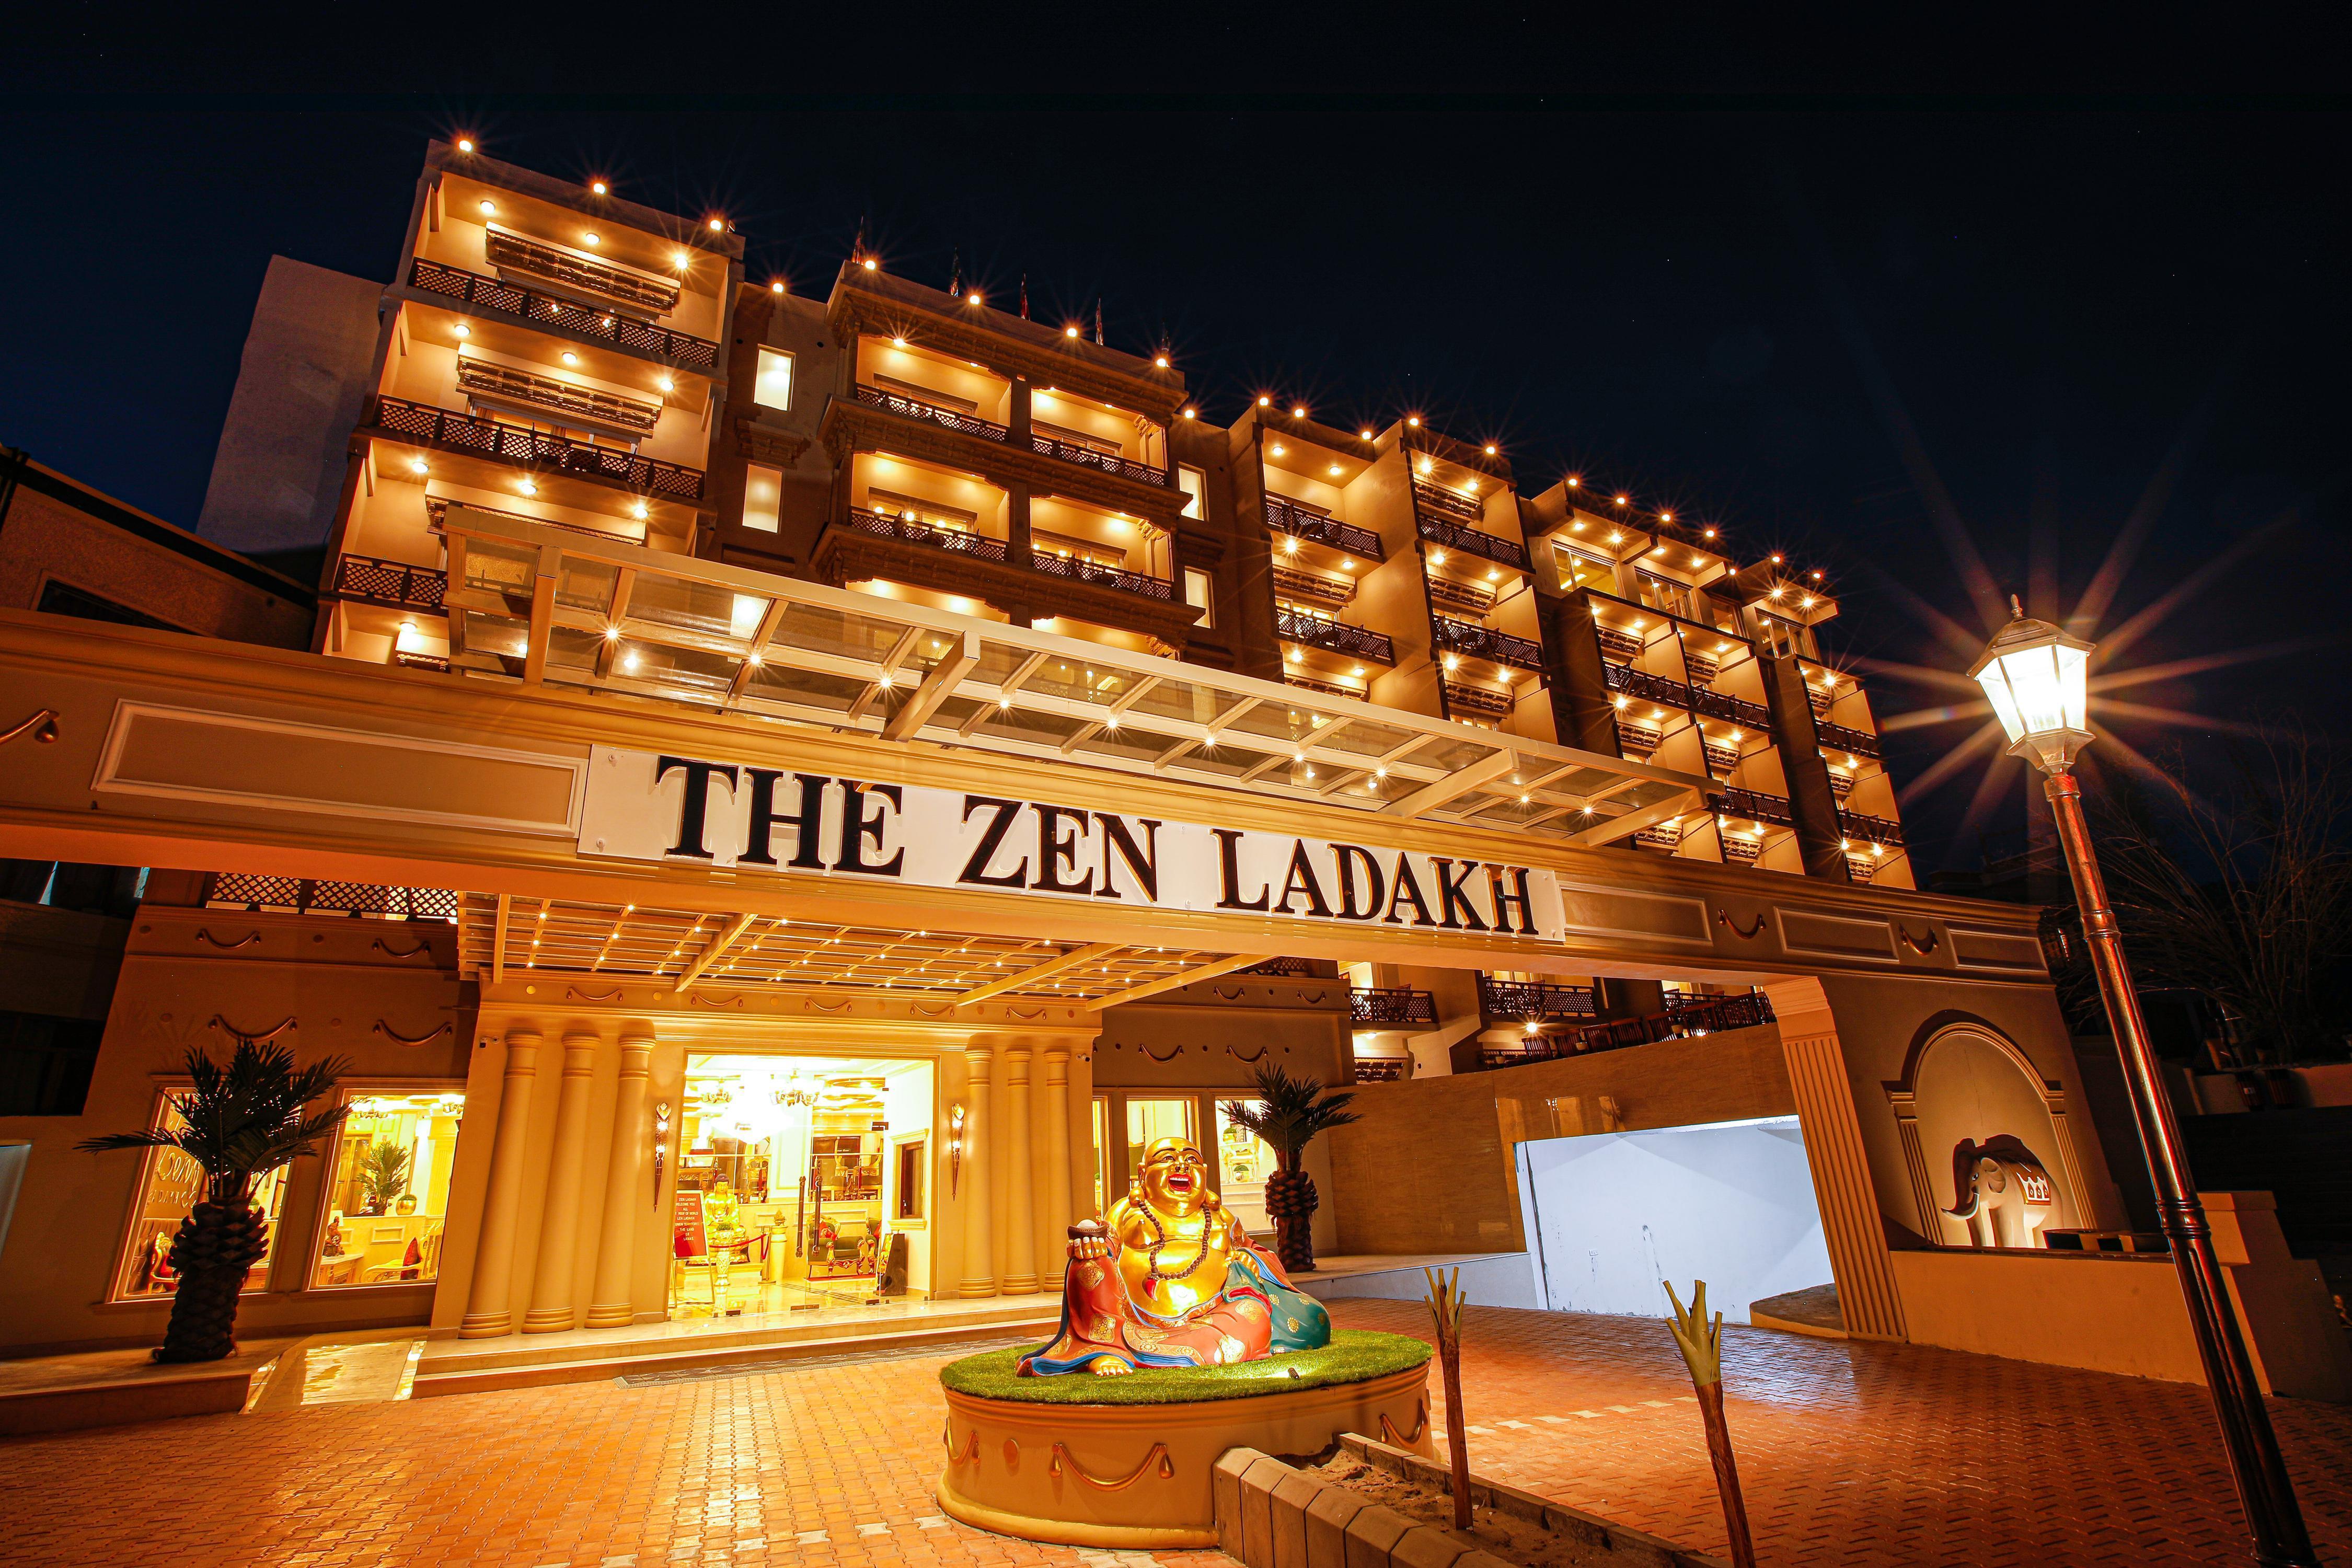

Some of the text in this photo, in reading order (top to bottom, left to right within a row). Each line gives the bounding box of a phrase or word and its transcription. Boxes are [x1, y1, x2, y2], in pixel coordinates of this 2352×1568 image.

[655, 755, 1540, 936] THE ZEN LADAKH
